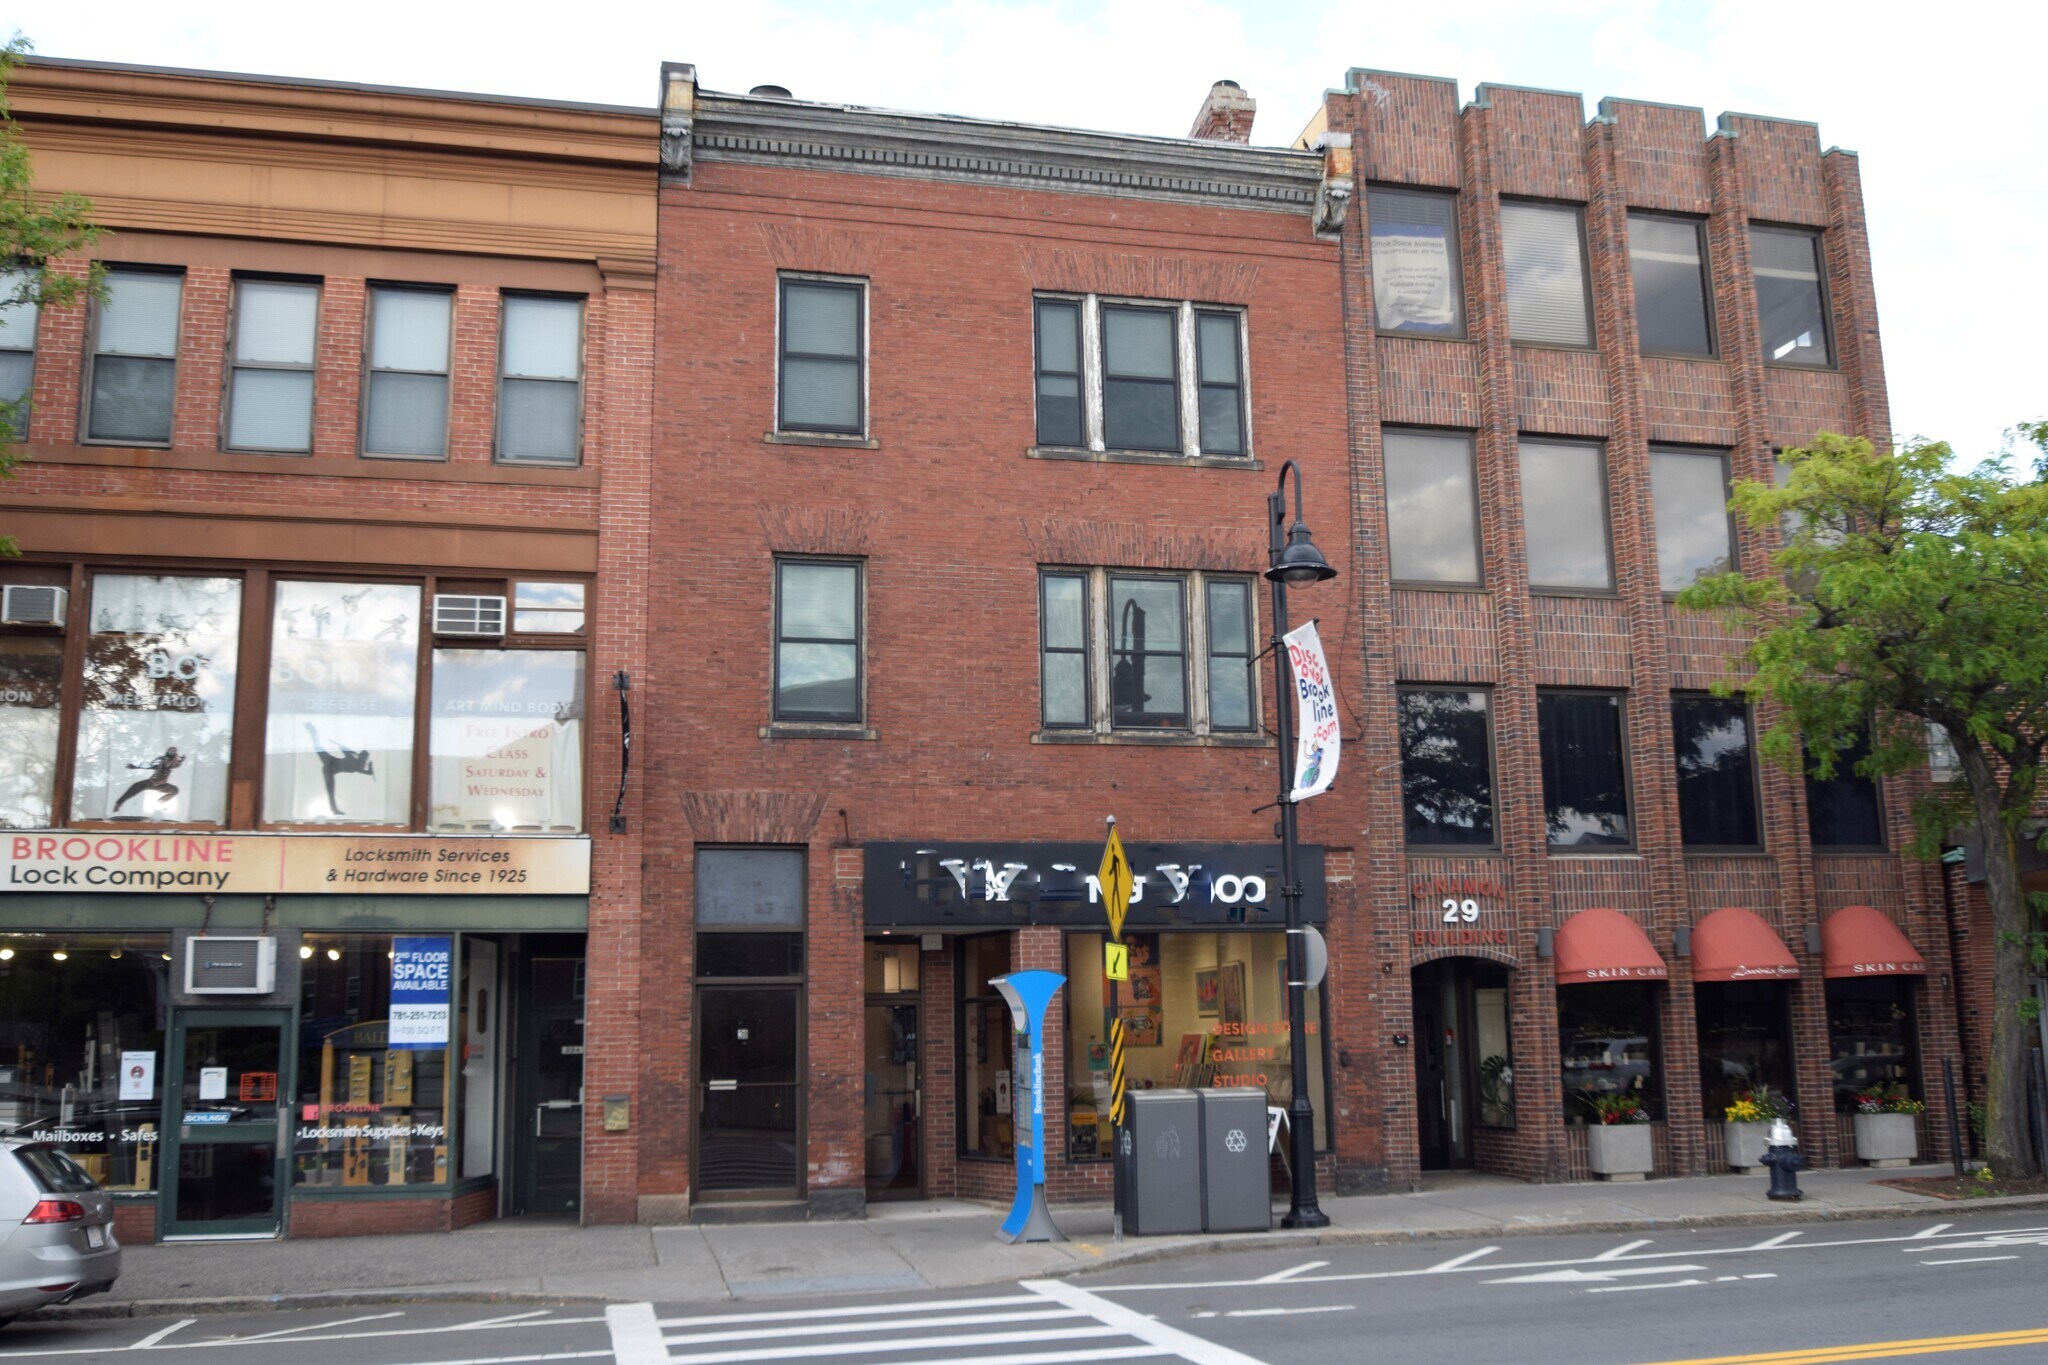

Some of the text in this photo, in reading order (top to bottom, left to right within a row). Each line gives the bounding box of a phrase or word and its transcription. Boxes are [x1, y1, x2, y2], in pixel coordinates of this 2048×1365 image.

[1299, 678, 1330, 703] Brook
[445, 700, 572, 714] ART MIND BODY
[1312, 700, 1334, 722] line
[535, 766, 546, 778] &
[11, 836, 235, 863] BROOKLINE
[345, 848, 510, 863] Locksmith Services
[10, 865, 231, 889] Lock Company
[326, 868, 527, 883] & Hardware Since 1925
[1413, 879, 1506, 900] CINAMON
[1442, 899, 1479, 922] 29
[1413, 929, 1508, 945] BUILDING
[412, 952, 449, 963] FLOOR
[393, 963, 449, 980] SPACE
[1586, 967, 1630, 978] SKIN
[1853, 963, 1897, 973] SKIN
[392, 980, 448, 991] AVAILABLE
[1212, 1022, 1267, 1036] DESIGN
[1212, 1047, 1274, 1062] GALLERY
[1212, 1073, 1268, 1088] STUDIO
[322, 1103, 382, 1112] BROOKLINE
[32, 1129, 158, 1143] Mailboxes Safes
[302, 1123, 444, 1139] Locksmith Supplies Keys
